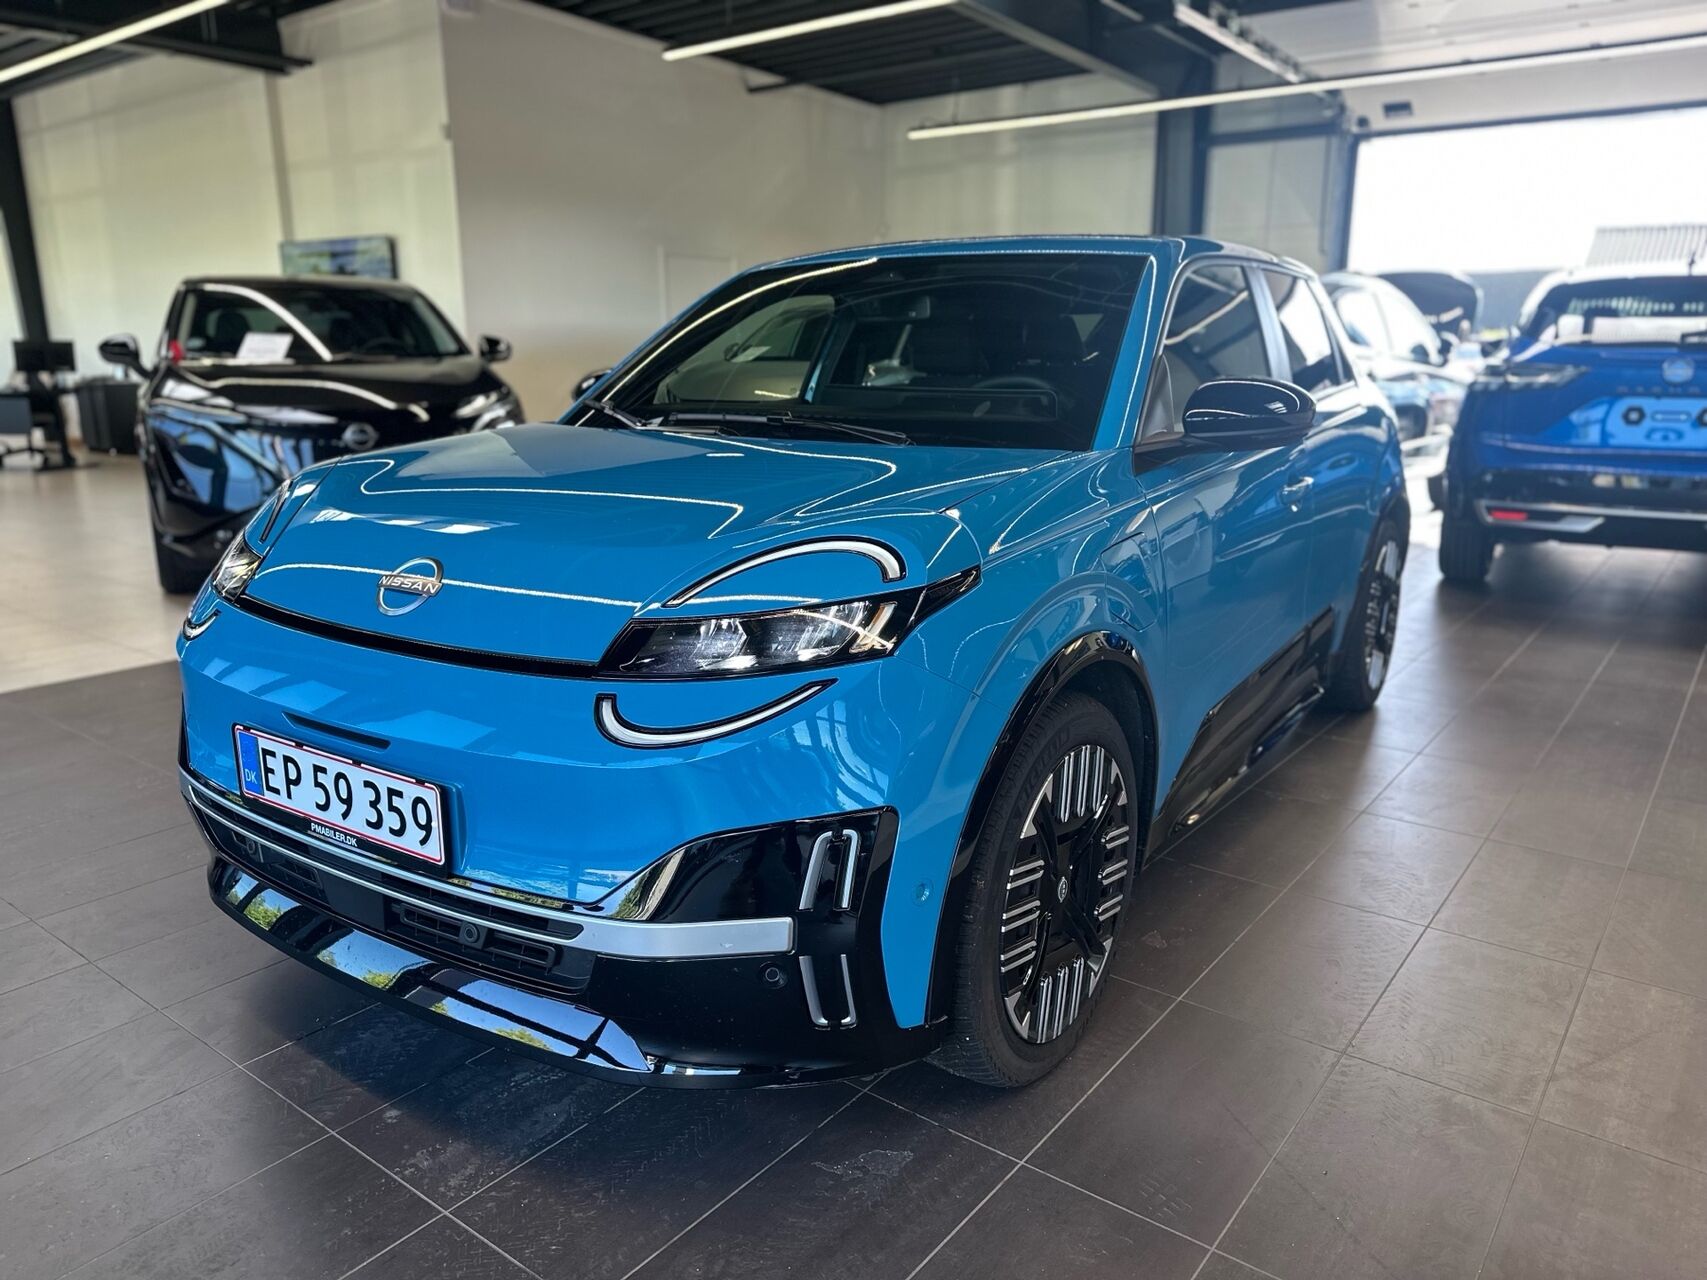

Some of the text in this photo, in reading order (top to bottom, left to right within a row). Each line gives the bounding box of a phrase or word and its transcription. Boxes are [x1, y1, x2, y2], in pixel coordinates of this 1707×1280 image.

[378, 575, 439, 594] NISSAN
[245, 768, 259, 785] DK
[261, 747, 433, 847] EP 59 359
[310, 822, 358, 847] PMABILER.DK
